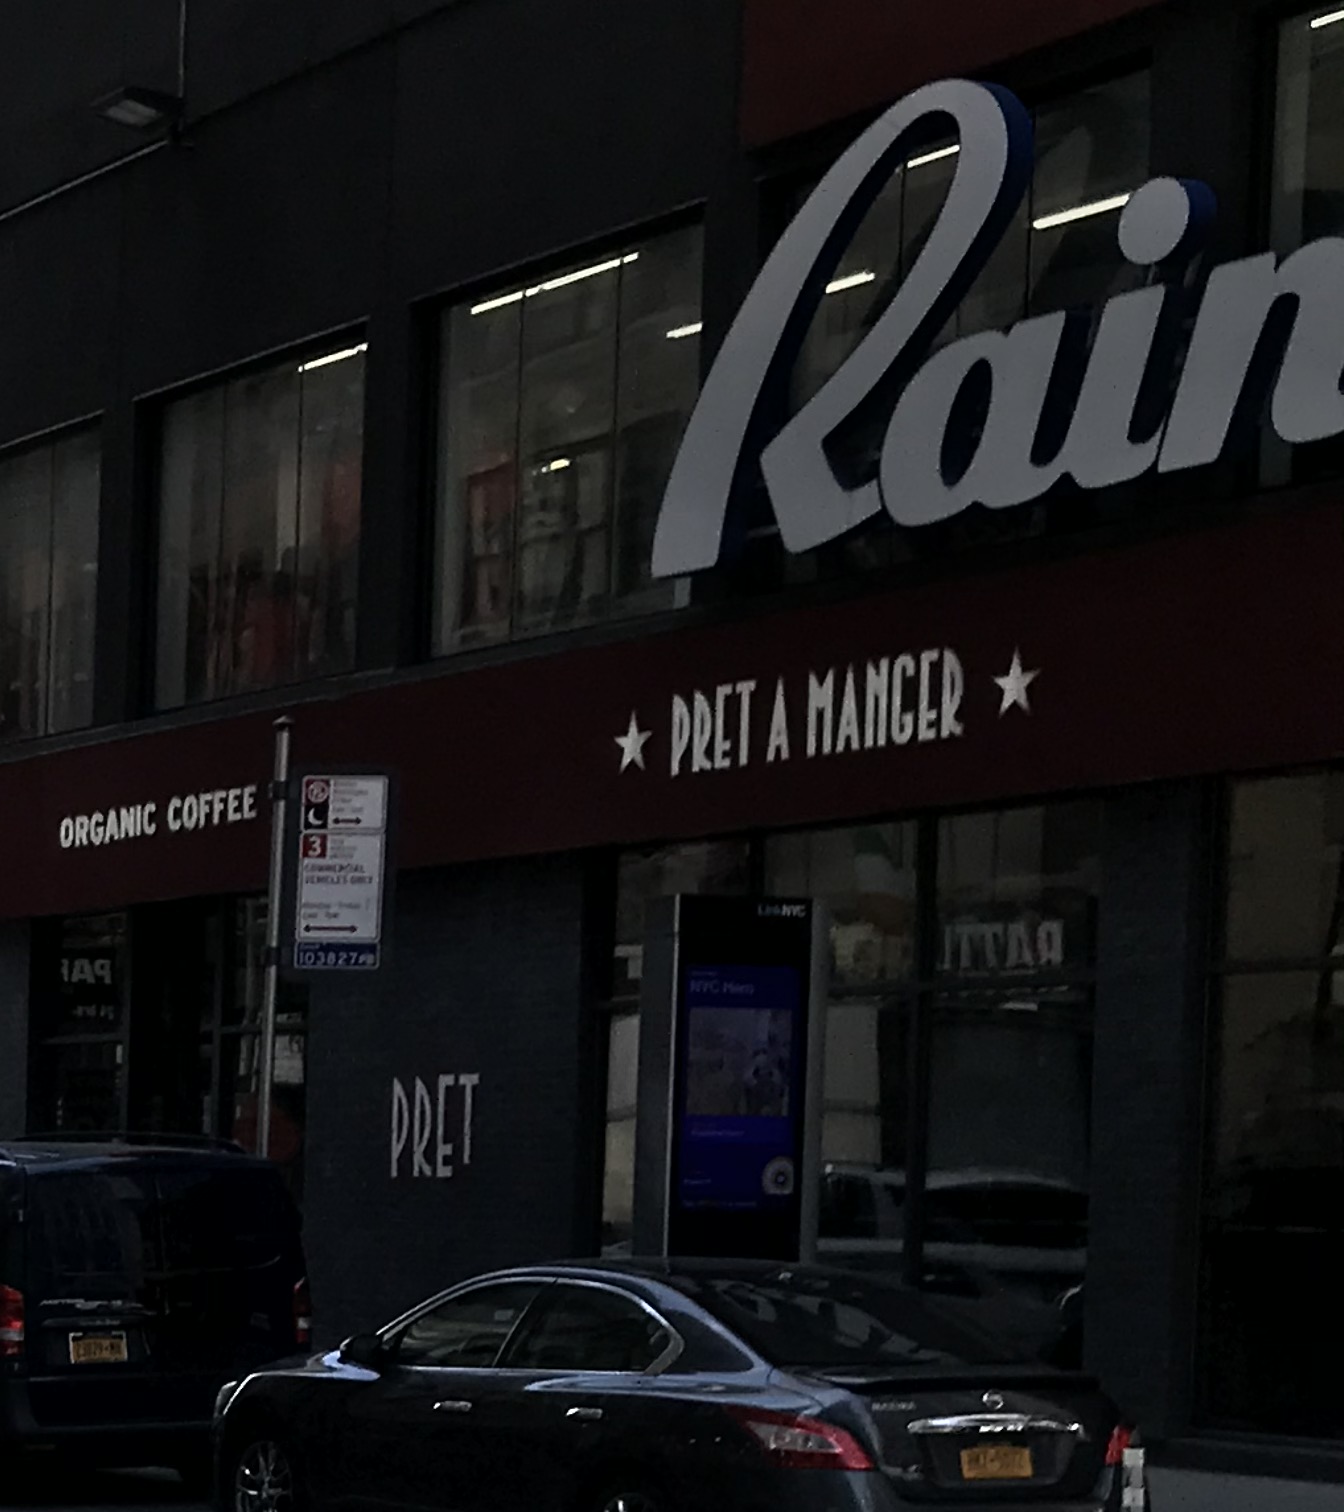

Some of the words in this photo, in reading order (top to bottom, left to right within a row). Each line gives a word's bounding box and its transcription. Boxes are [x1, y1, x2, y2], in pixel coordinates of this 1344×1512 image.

[670, 679, 757, 778] PRET
[766, 675, 790, 763] A
[805, 648, 965, 759] MANGER
[59, 801, 157, 848] ORGANIC
[167, 785, 258, 832] COFFEE
[307, 835, 322, 857] 3
[391, 1073, 480, 1178] PRET
